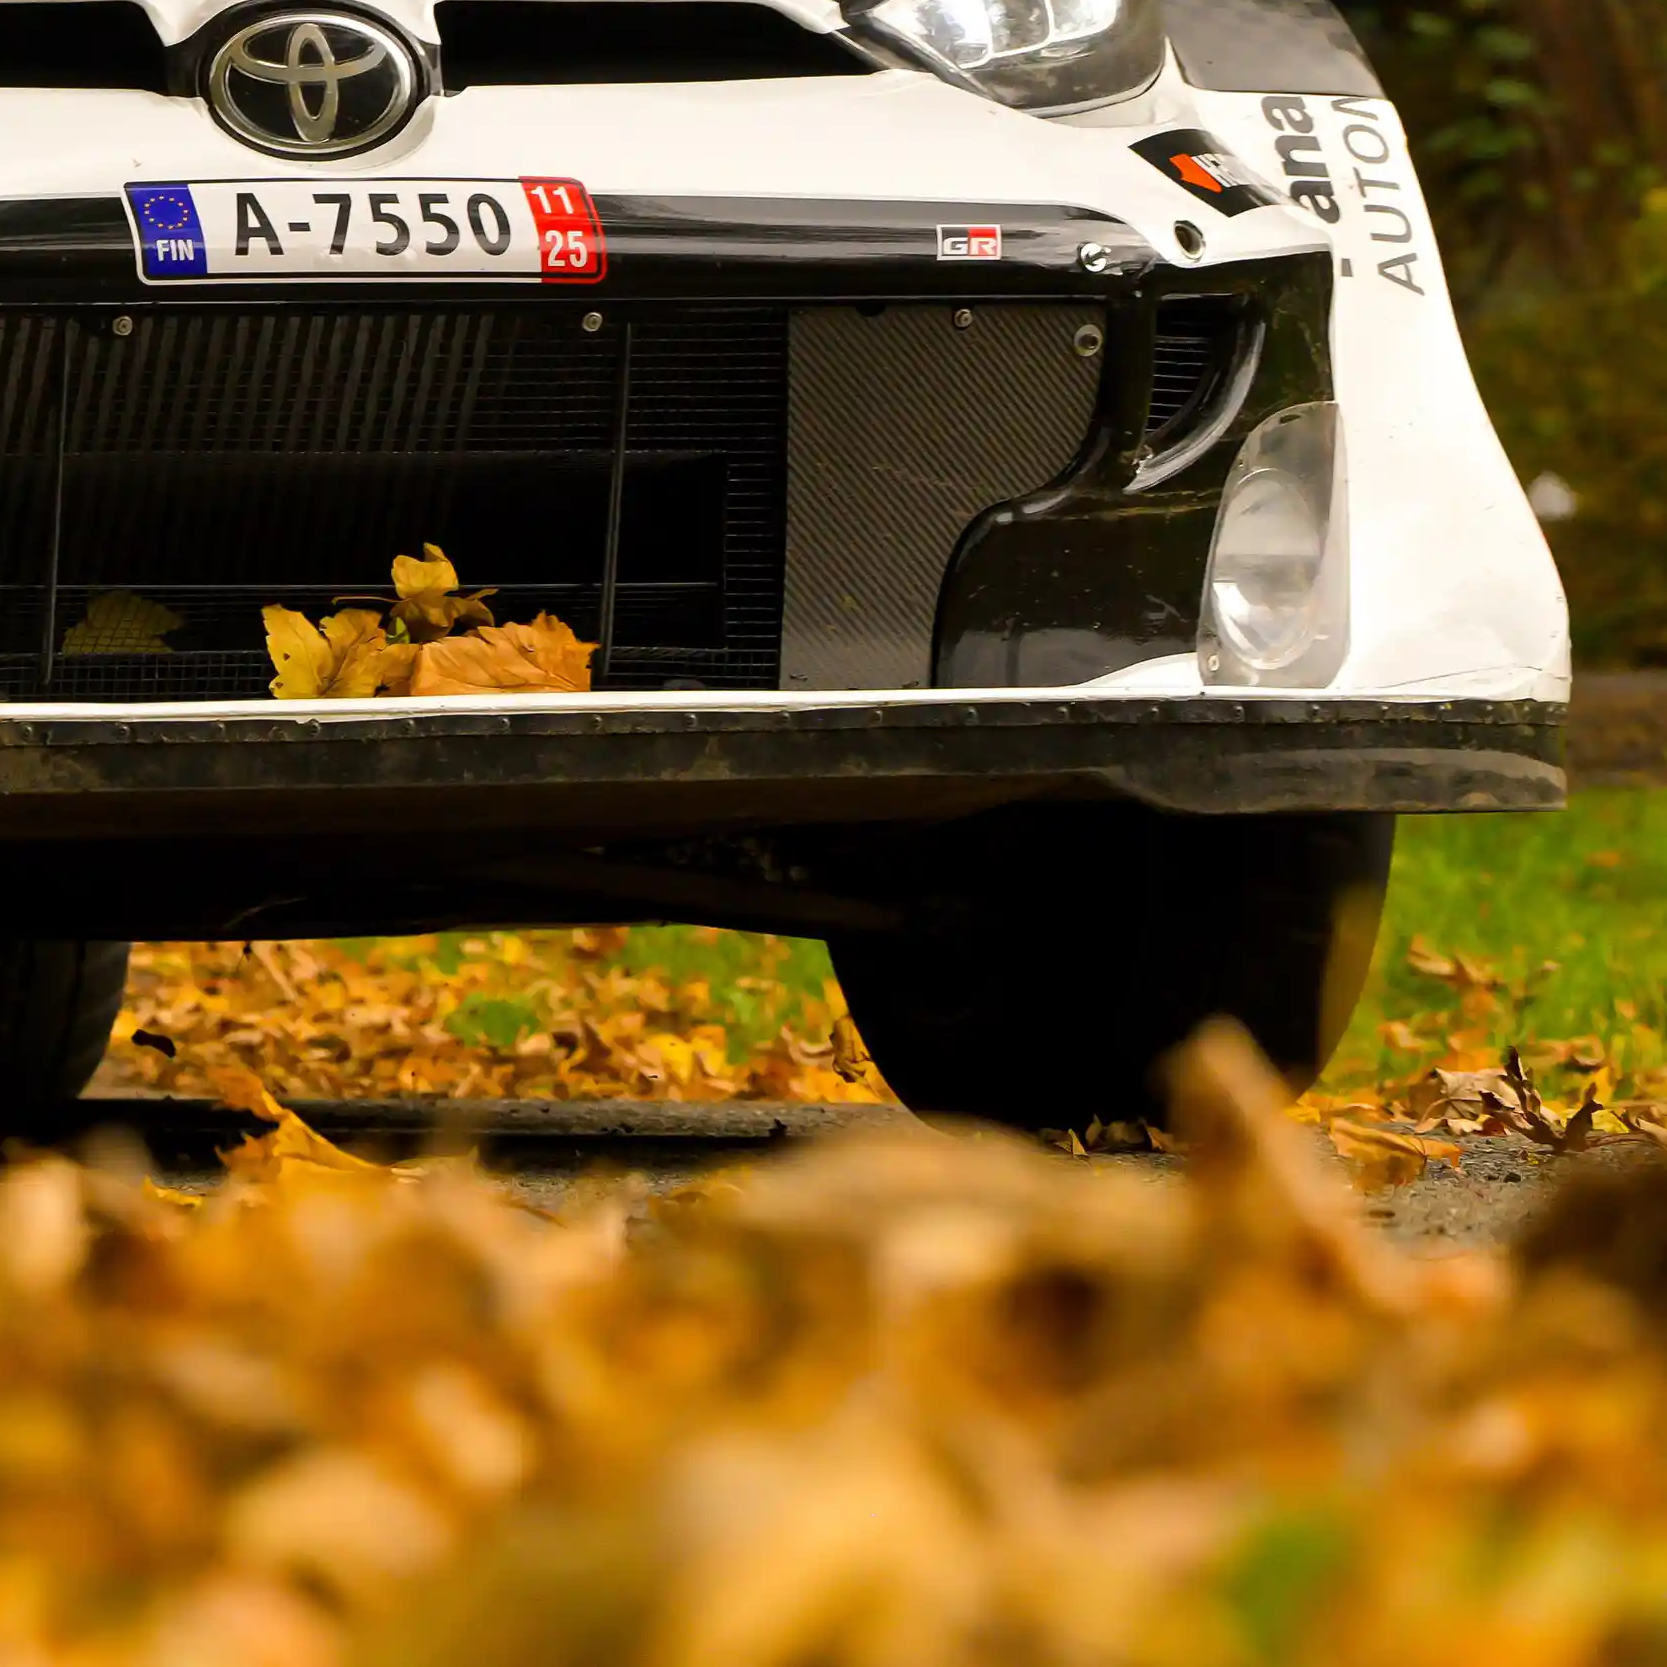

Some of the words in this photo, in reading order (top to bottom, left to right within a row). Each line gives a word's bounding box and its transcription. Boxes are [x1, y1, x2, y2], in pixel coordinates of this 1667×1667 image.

[530, 184, 575, 215] 11
[233, 191, 513, 257] A-7550
[156, 238, 195, 262] FIN
[544, 230, 589, 270] 25
[942, 236, 997, 255] GR
